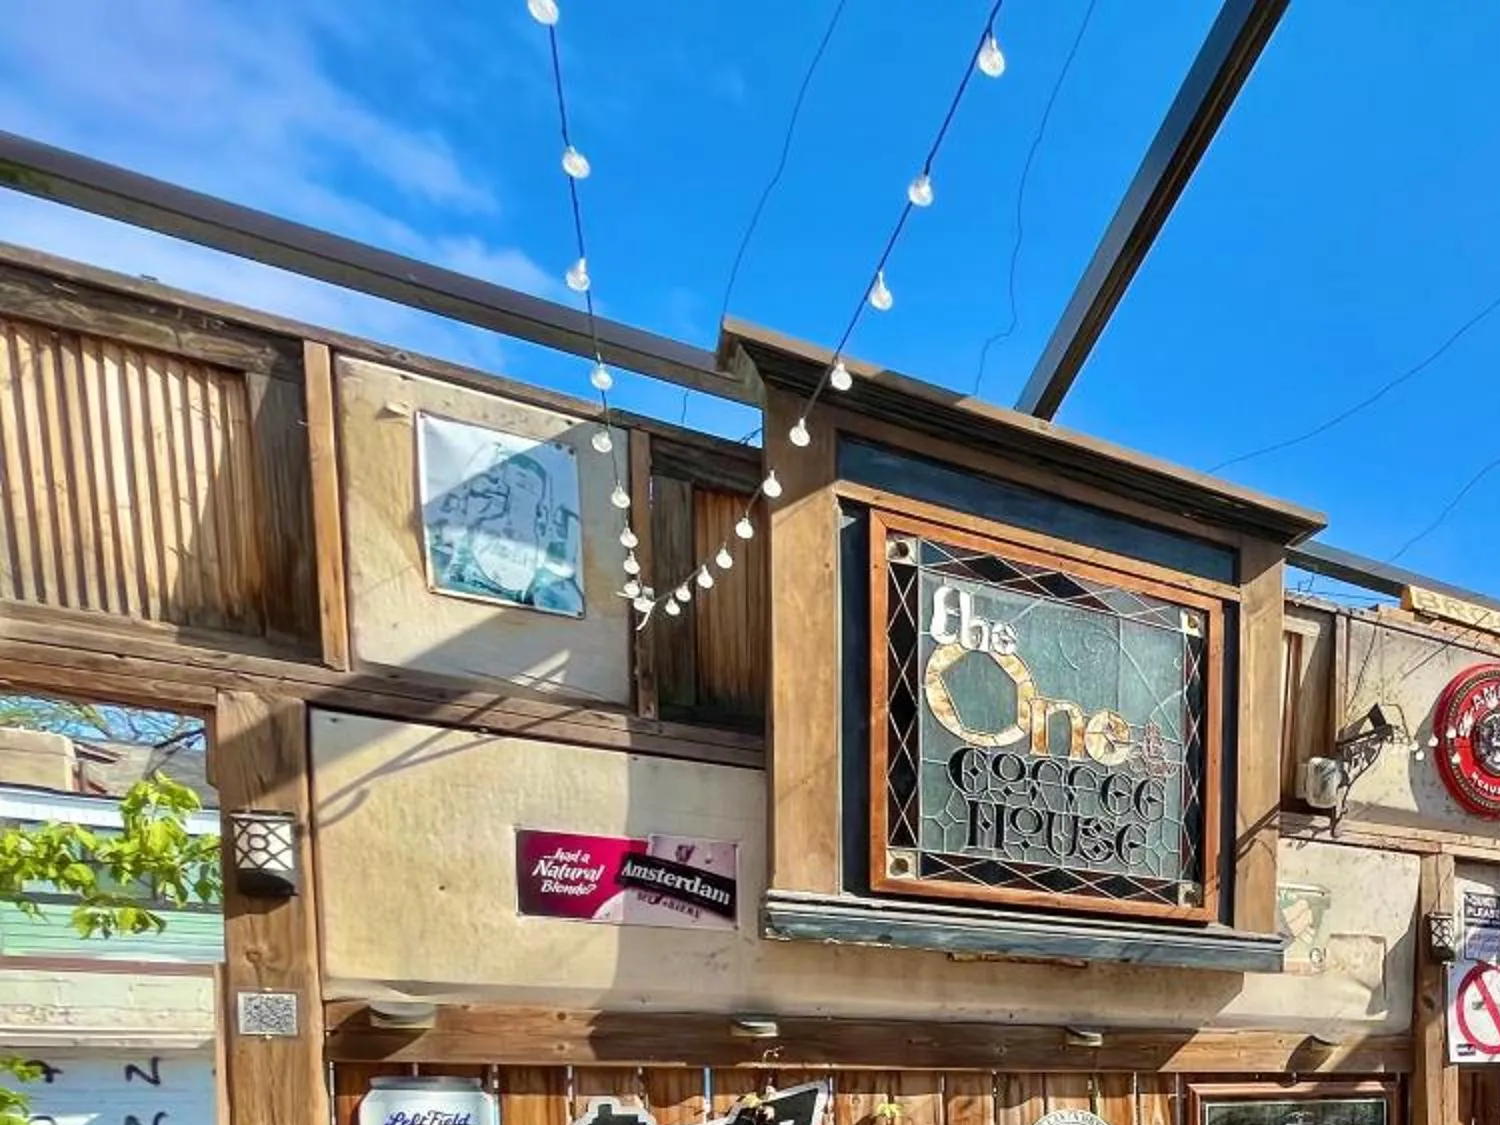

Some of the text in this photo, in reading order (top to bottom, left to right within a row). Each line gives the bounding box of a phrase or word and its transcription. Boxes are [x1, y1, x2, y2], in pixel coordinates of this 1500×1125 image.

[966, 802, 1147, 866] HOUSE
[531, 860, 606, 883] Natural
[621, 859, 730, 905] Amsterdam
